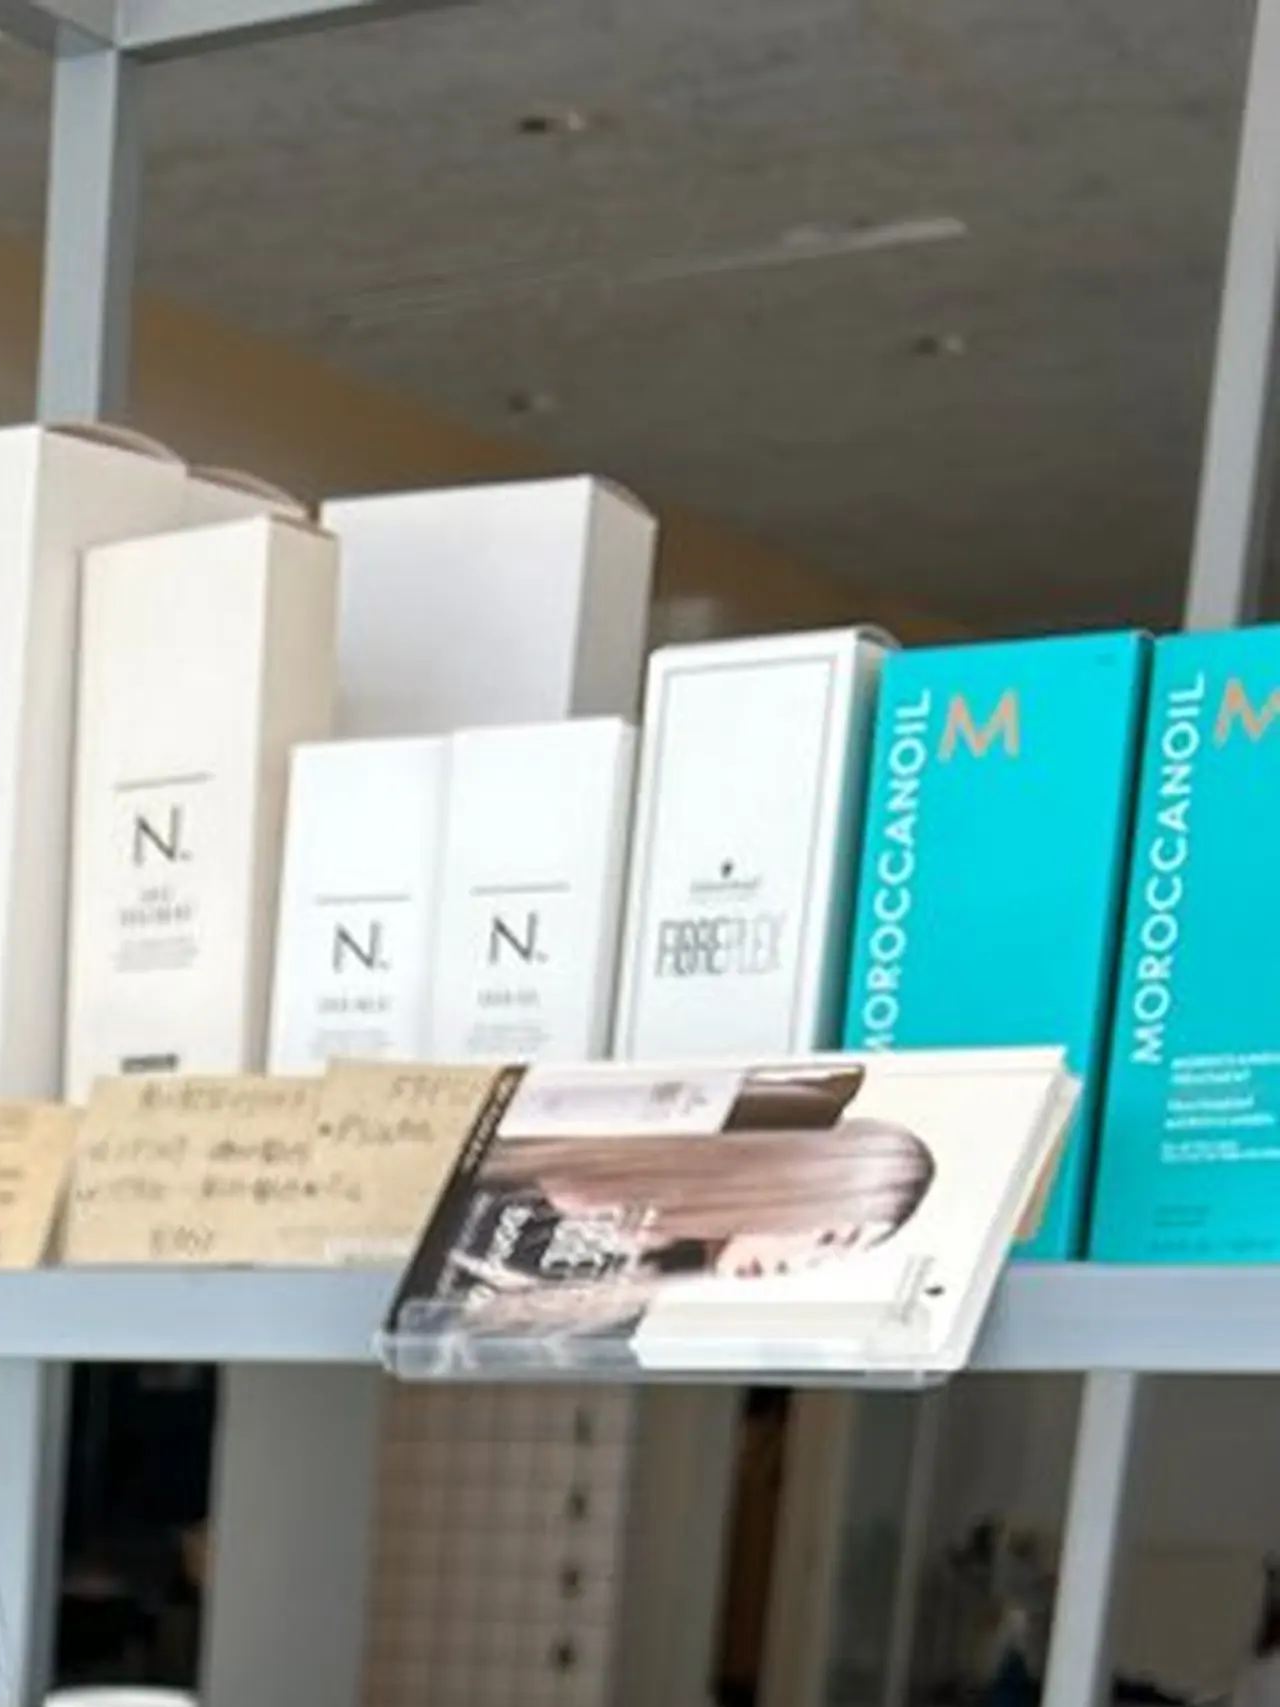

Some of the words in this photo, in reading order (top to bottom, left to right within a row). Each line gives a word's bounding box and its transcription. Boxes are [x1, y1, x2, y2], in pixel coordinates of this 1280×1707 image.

[938, 688, 1020, 762] M
[132, 804, 193, 867] N.
[1130, 672, 1206, 1064] MOROCCANOIL
[331, 918, 391, 974] N.
[488, 910, 550, 965] N.
